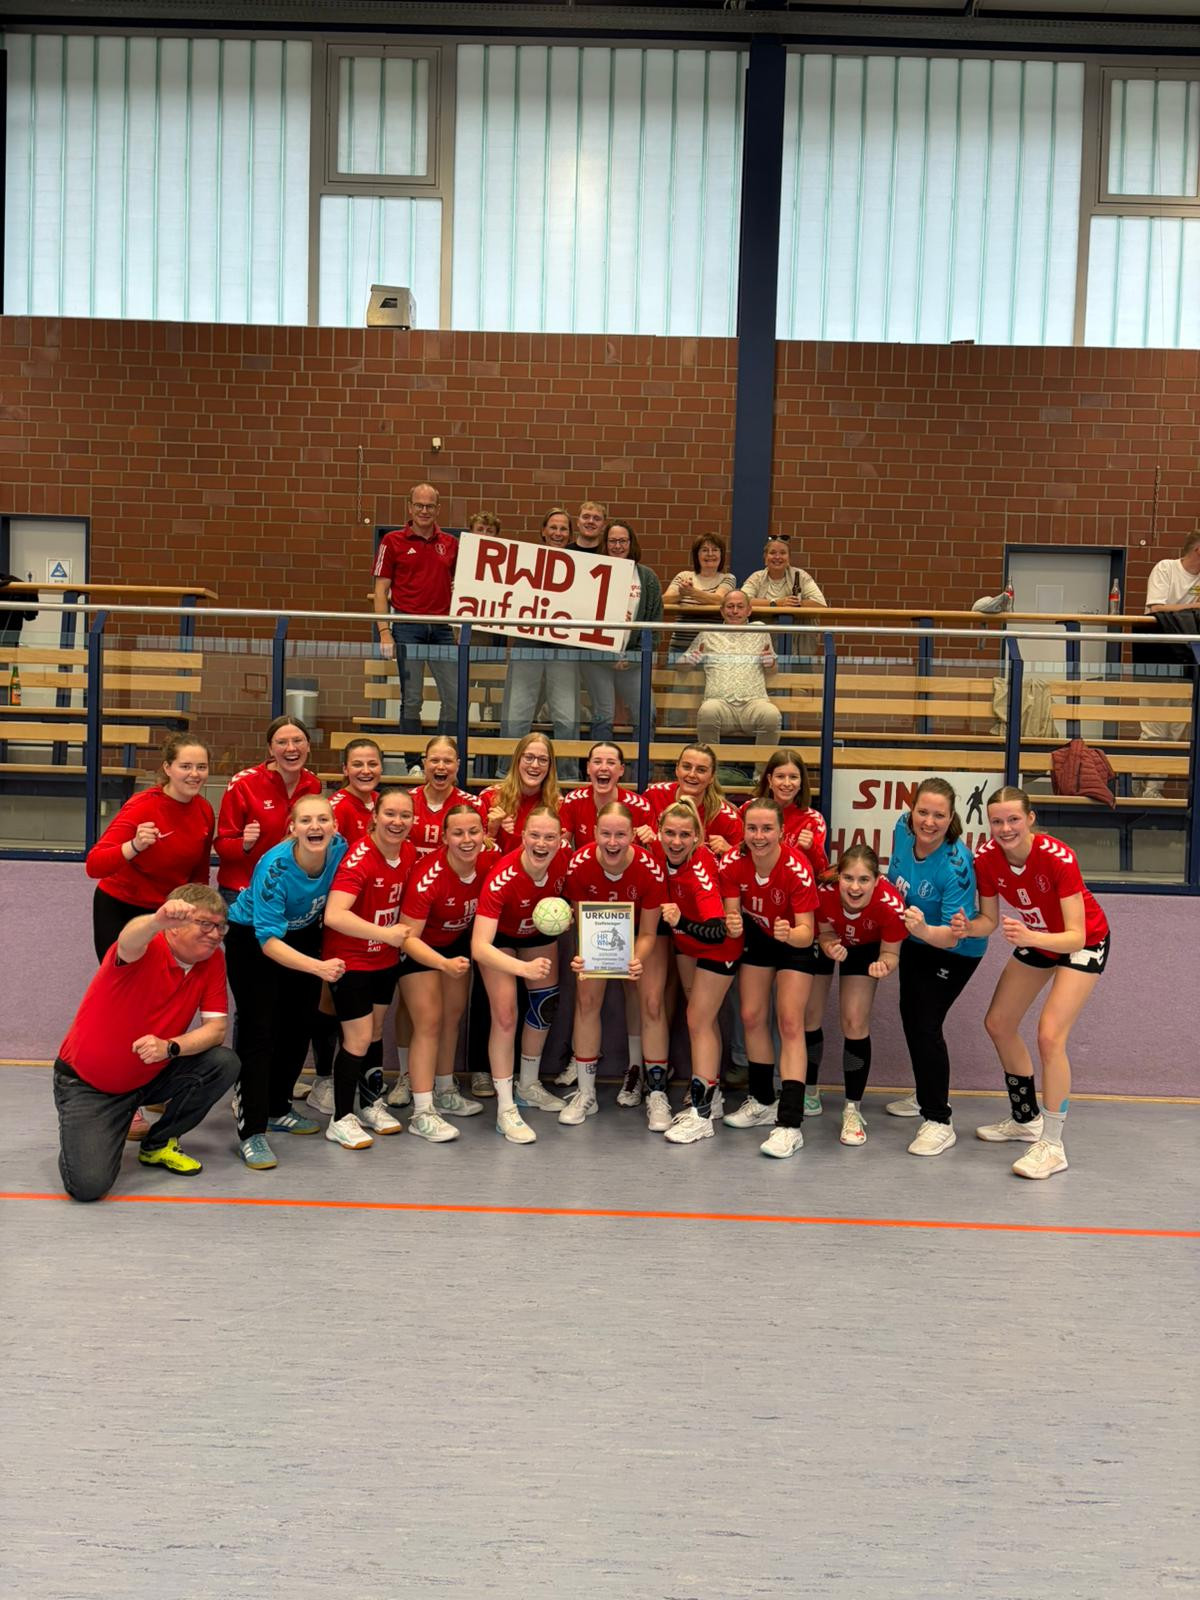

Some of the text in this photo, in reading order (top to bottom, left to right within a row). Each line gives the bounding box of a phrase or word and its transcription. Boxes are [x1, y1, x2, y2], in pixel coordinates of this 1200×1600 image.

[475, 539, 575, 592] RWD
[579, 564, 615, 646] 1
[456, 591, 573, 640] auf die
[852, 779, 919, 810] SIN
[425, 824, 439, 843] 13
[388, 882, 403, 904] 21
[1016, 888, 1032, 906] 8
[752, 896, 763, 912] 11
[585, 912, 631, 920] URKUNDE
[845, 924, 856, 938] 9
